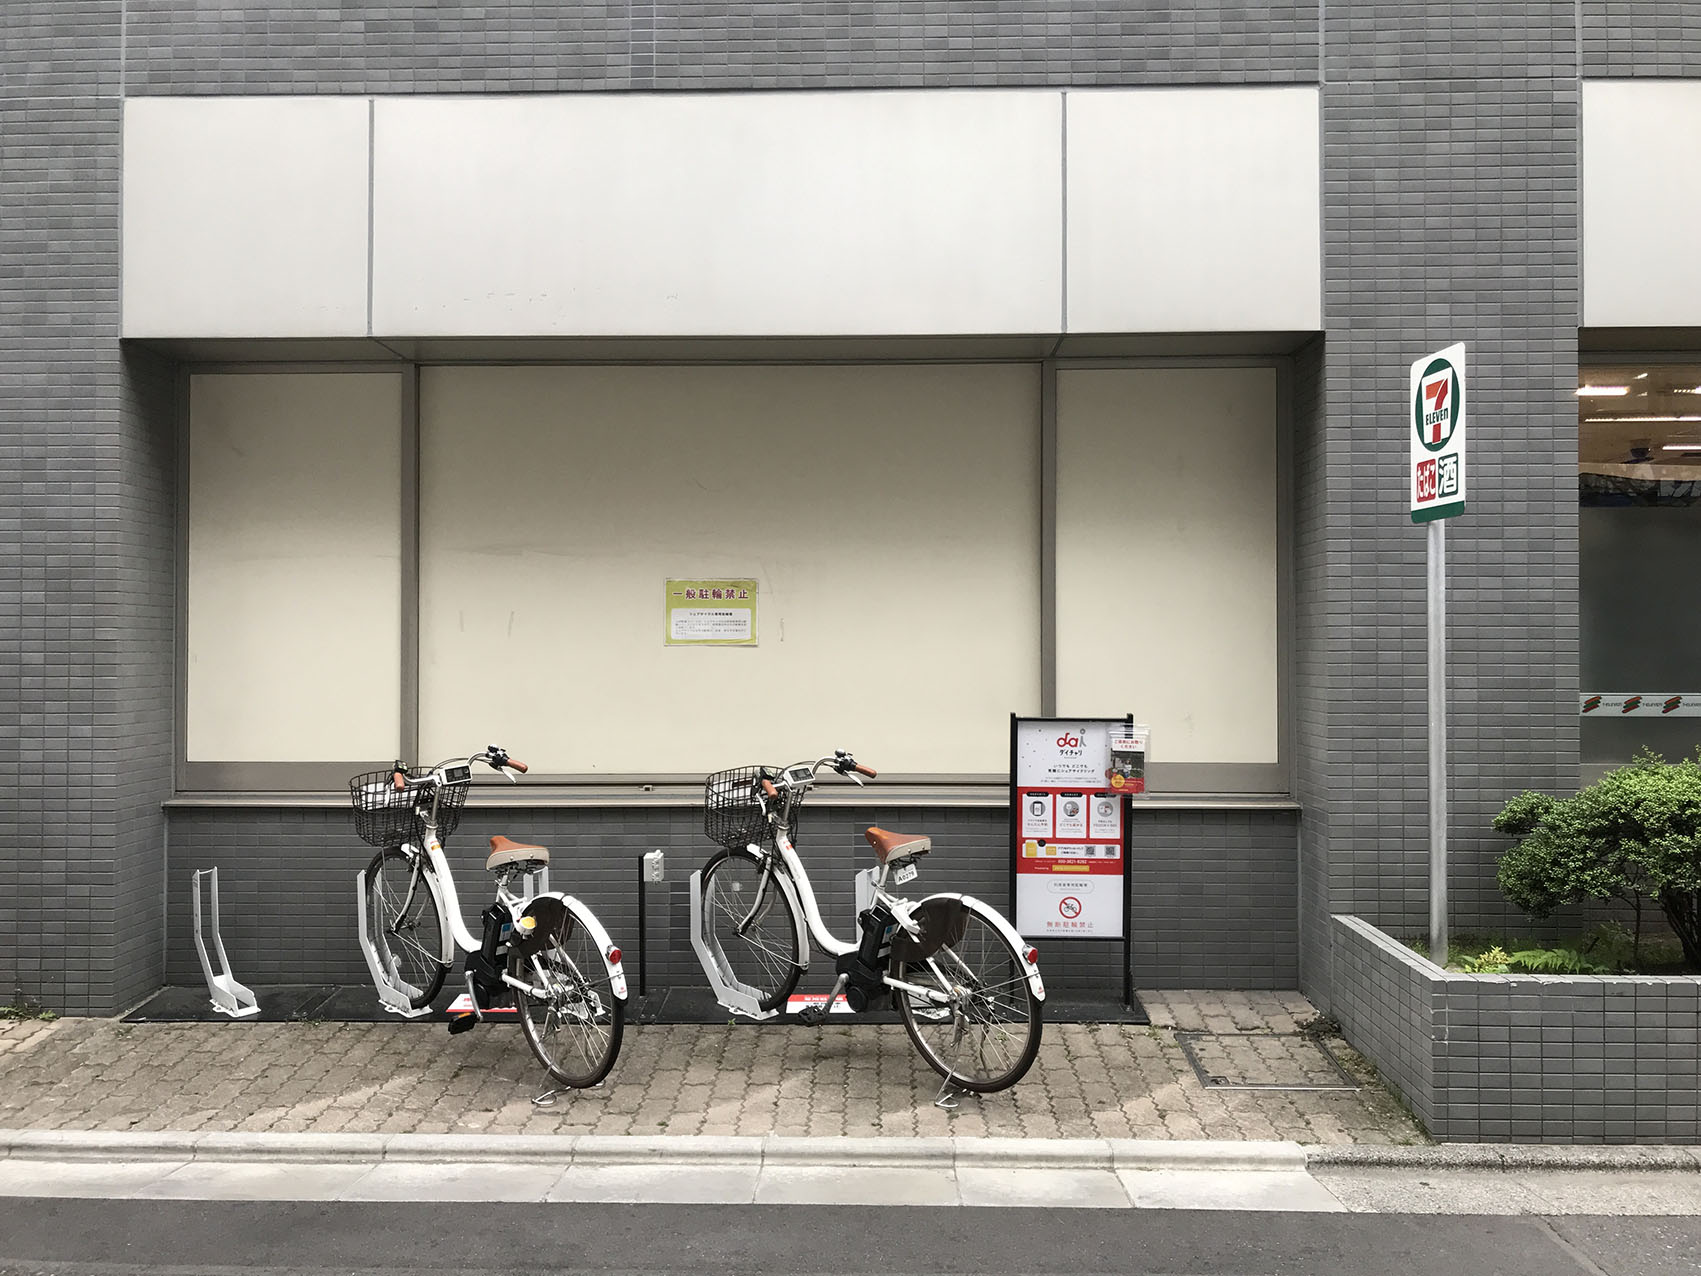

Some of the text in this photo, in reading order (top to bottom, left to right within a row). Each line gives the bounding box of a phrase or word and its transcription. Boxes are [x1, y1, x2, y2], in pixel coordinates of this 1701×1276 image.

[1425, 378, 1449, 445] 7
[1417, 464, 1437, 499] たばこ
[1438, 456, 1458, 495] 酒
[672, 587, 749, 600] 一般駐輪禁止
